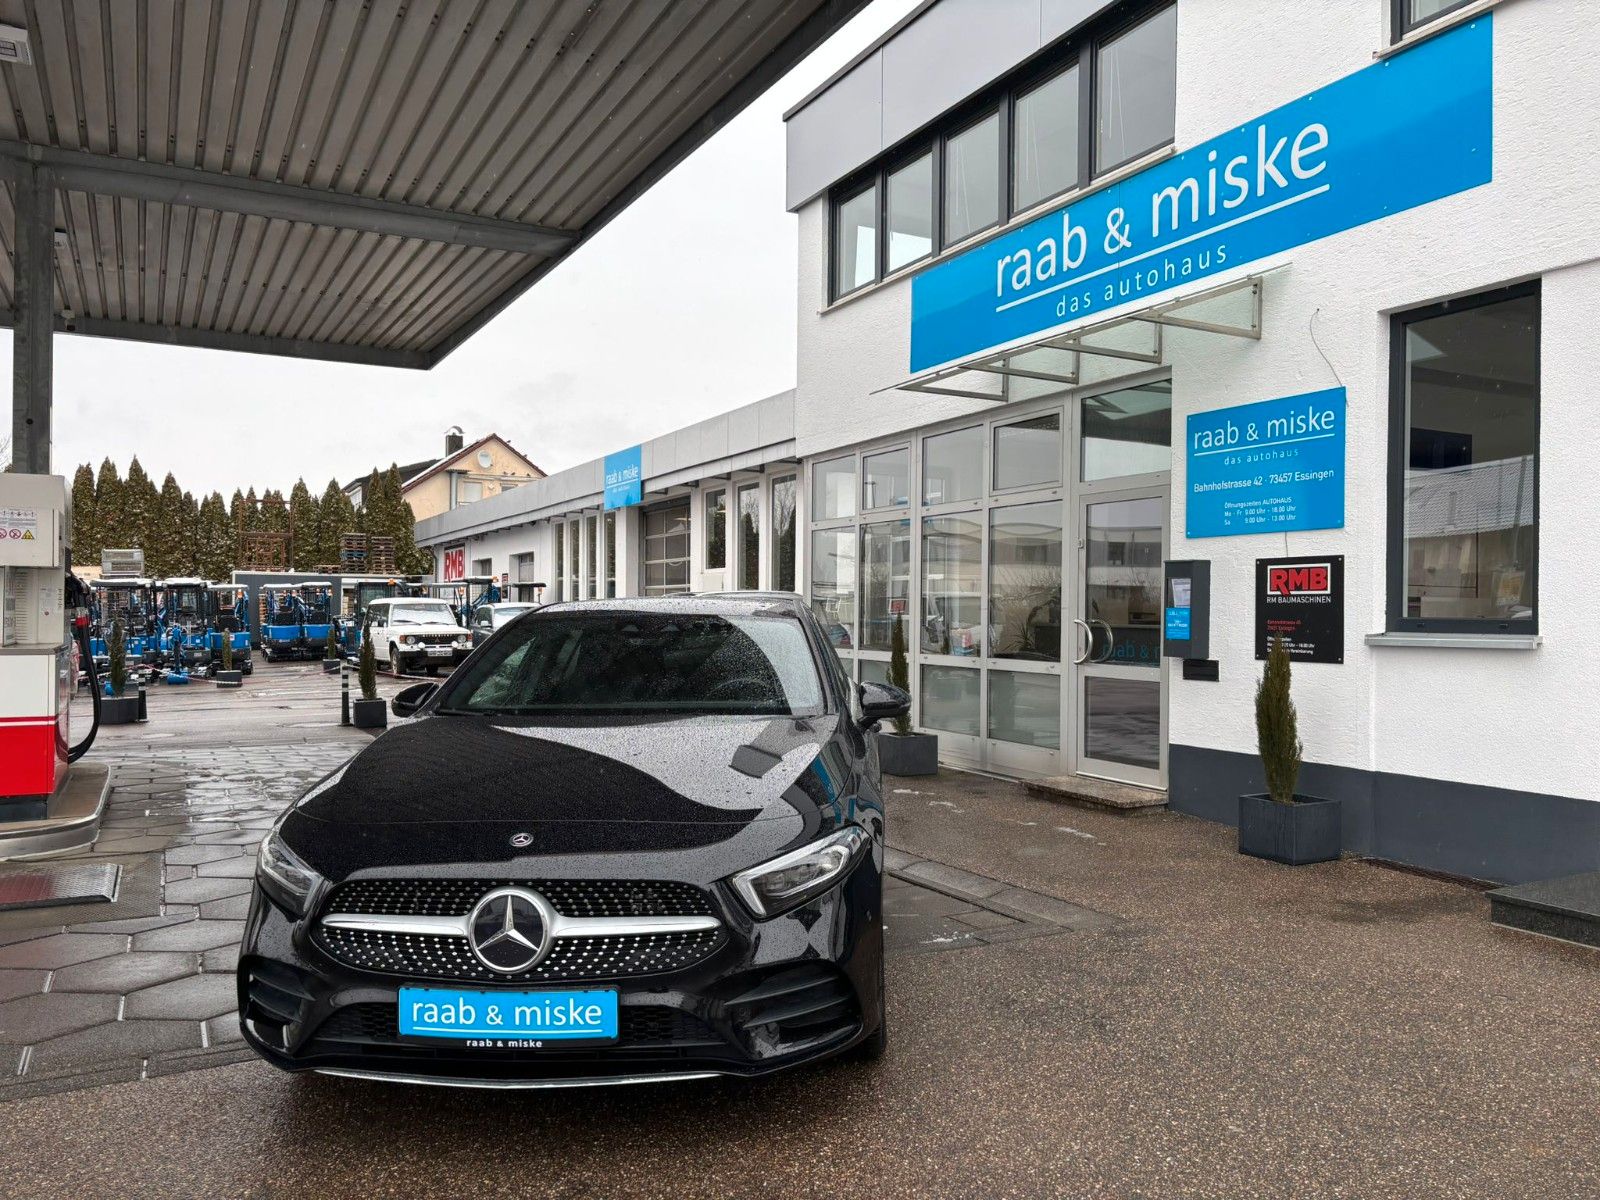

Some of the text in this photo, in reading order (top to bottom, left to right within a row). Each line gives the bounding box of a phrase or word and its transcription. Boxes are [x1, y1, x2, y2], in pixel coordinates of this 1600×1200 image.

[996, 122, 1329, 297] raab & miske
[1056, 244, 1227, 317] das autohaus
[1194, 405, 1335, 450] raab & miske
[1224, 449, 1299, 466] das autohaus
[1194, 478, 1252, 493] Bahnhofstrasse
[1253, 475, 1263, 487] 42
[1269, 472, 1292, 485] 73457
[1294, 468, 1334, 483] Essingen
[1262, 496, 1292, 505] AUTOHAUS
[444, 549, 465, 582] RMB
[1270, 566, 1328, 596] RMB
[1266, 595, 1332, 604] RM BAUMASCHINEN
[412, 997, 602, 1026] raab & miske
[466, 1038, 542, 1048] raab & miske
